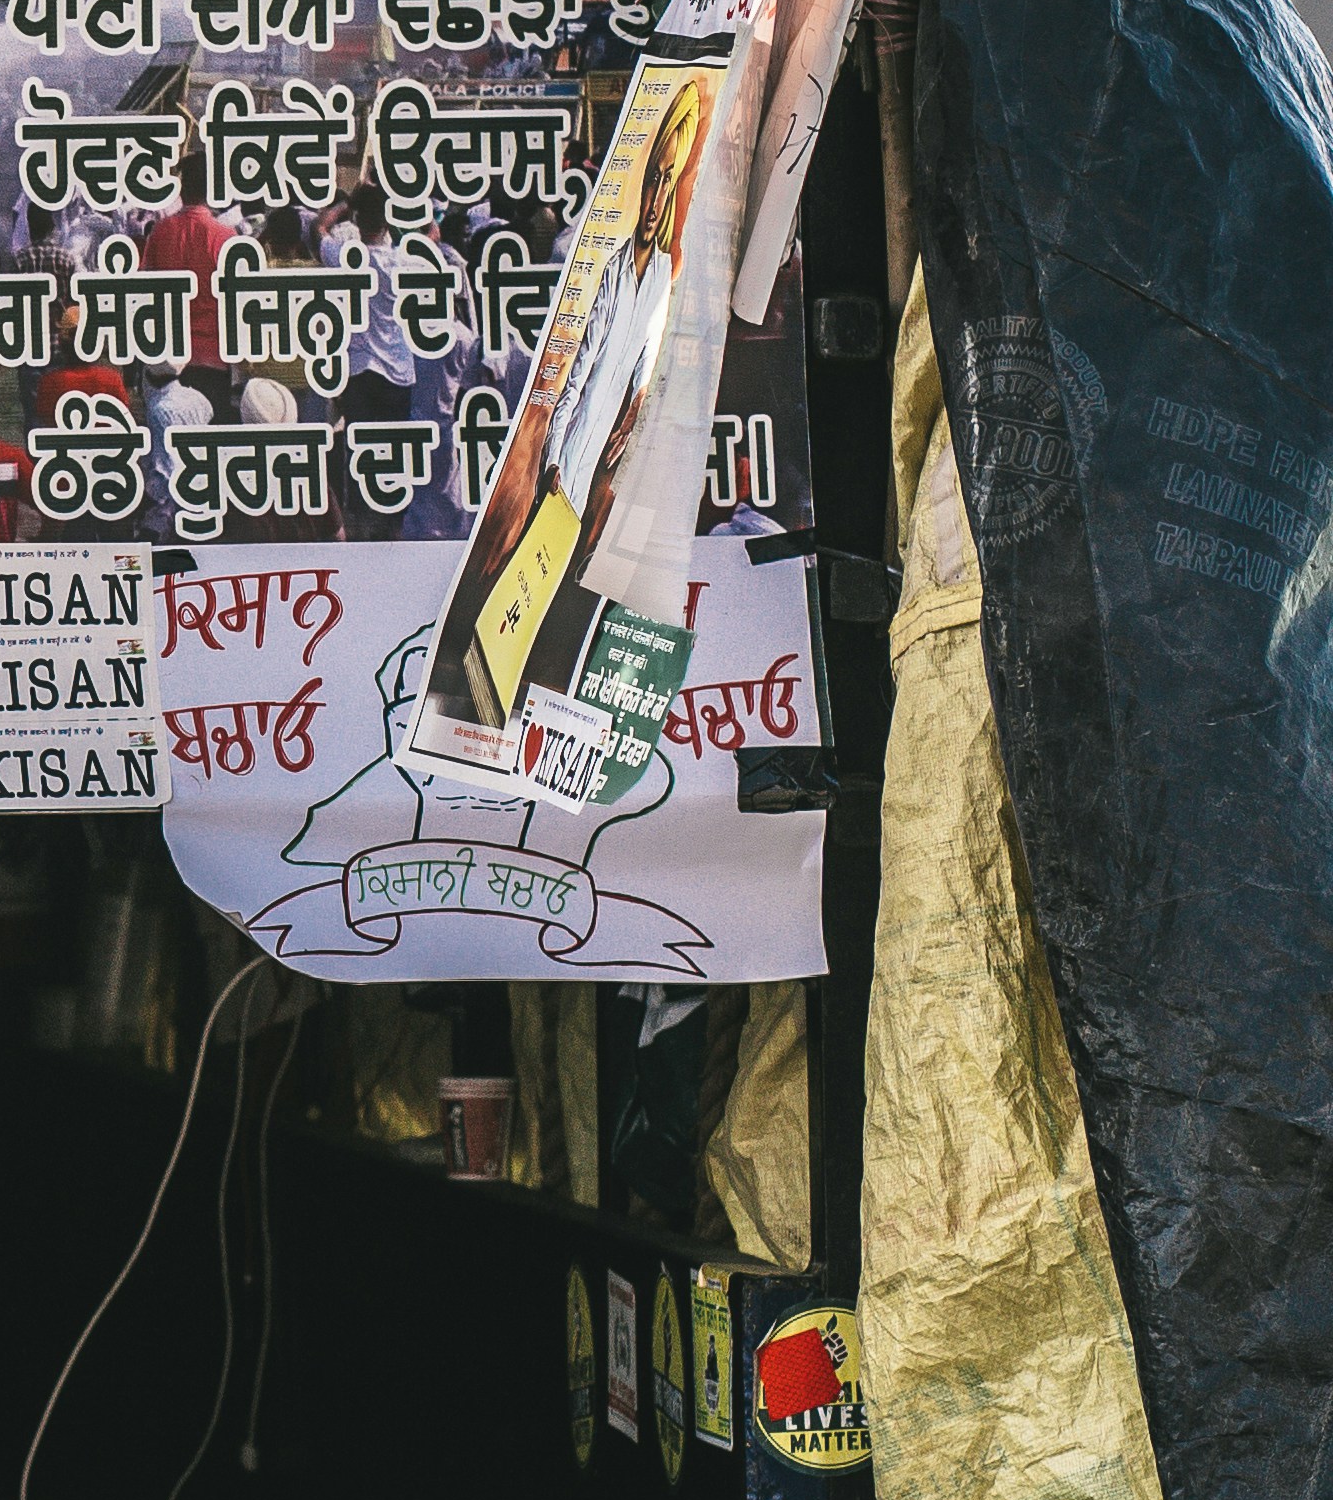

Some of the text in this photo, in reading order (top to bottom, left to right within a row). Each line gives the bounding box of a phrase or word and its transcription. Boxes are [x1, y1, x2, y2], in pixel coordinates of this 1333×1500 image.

[427, 83, 545, 97] ALA POLICE
[15, 78, 186, 213] ਹੋਵਣ
[201, 78, 354, 210] ਕਿਵੇਂ
[72, 235, 199, 366] ਸੰਗ
[389, 235, 463, 363] ਦੇ
[27, 392, 152, 521] ਠੰਡੇ
[165, 422, 334, 541] ਬੁਰਜ
[348, 422, 438, 515] ਦਾ
[533, 730, 605, 803] KISAN
[789, 1432, 872, 1454] MATTER
